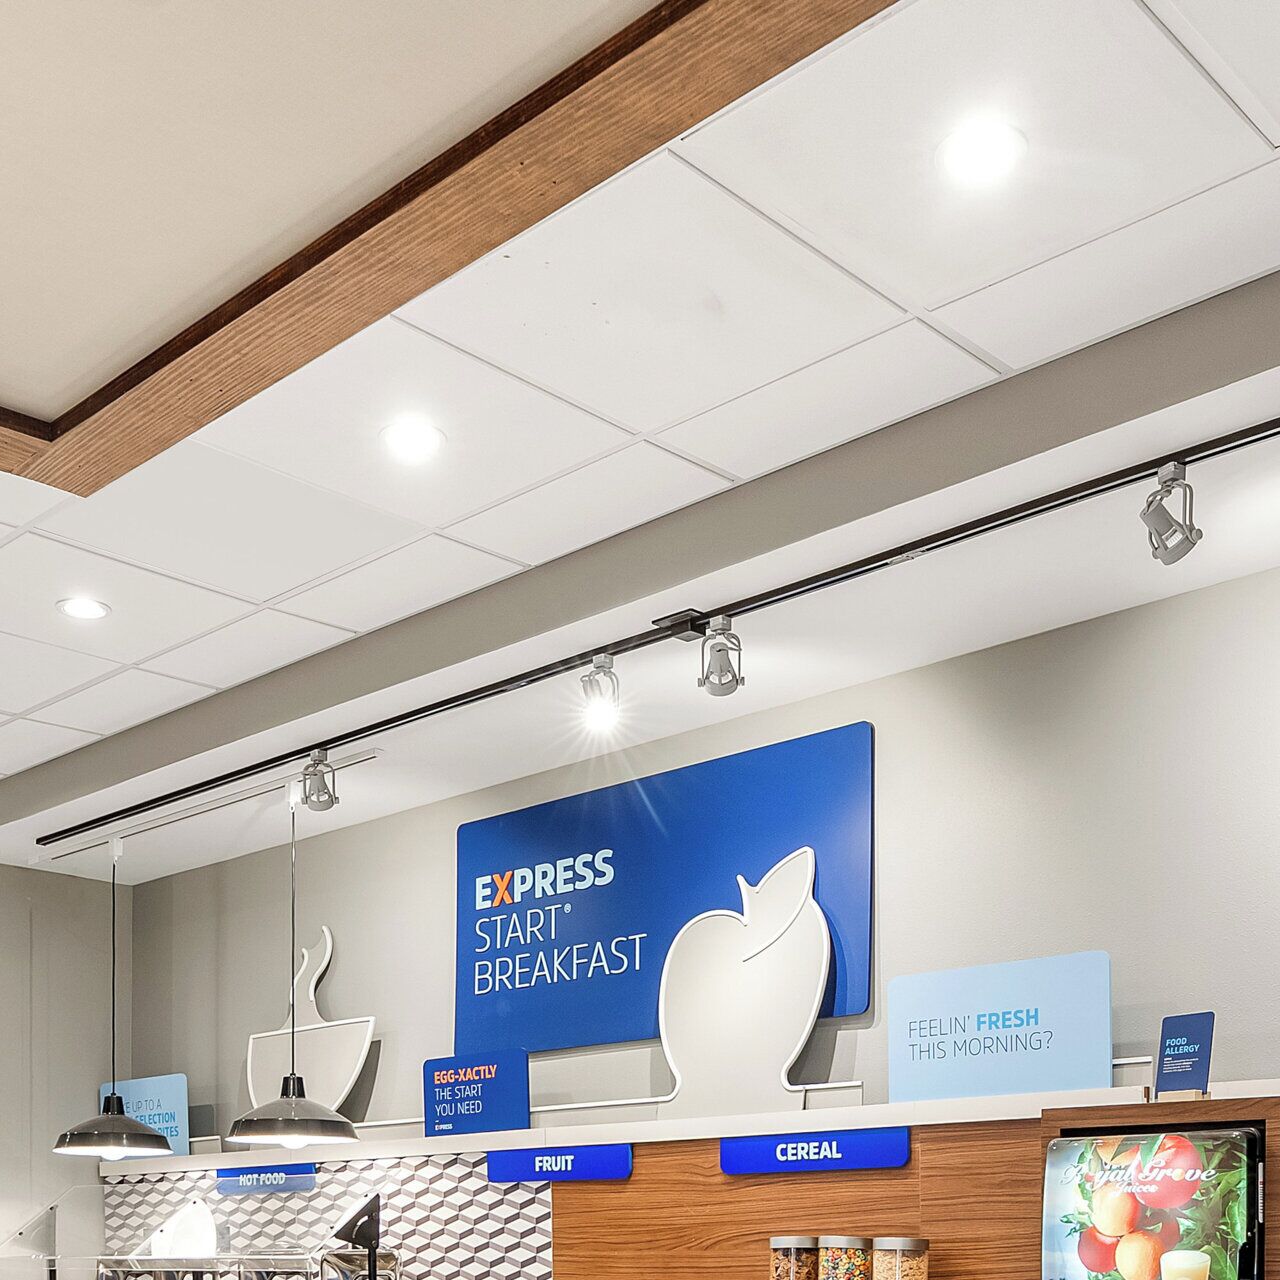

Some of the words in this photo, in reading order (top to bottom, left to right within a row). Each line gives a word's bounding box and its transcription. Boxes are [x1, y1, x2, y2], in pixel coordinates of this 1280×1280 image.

[475, 849, 615, 911] EXPRESS
[474, 933, 648, 995] BREAKFAST
[976, 1007, 1039, 1032] FRESH
[908, 1041, 947, 1061] THIS
[953, 1030, 1054, 1058] MORNING?
[1165, 1044, 1200, 1055] ALLERGY
[1166, 1037, 1188, 1047] FOOD
[434, 1064, 497, 1085] EGG-XACTLY
[434, 1087, 452, 1101] THE
[455, 1083, 483, 1099] START
[132, 1100, 143, 1113] UP
[144, 1098, 155, 1111] TO
[156, 1099, 162, 1109] A
[435, 1103, 455, 1116] YOU
[457, 1100, 483, 1114] NEED
[775, 1141, 842, 1161] CEREAL
[534, 1155, 575, 1172] FRUIT
[1138, 1158, 1219, 1182] Grove
[240, 1174, 257, 1186] HOT
[260, 1172, 286, 1185] FOOD
